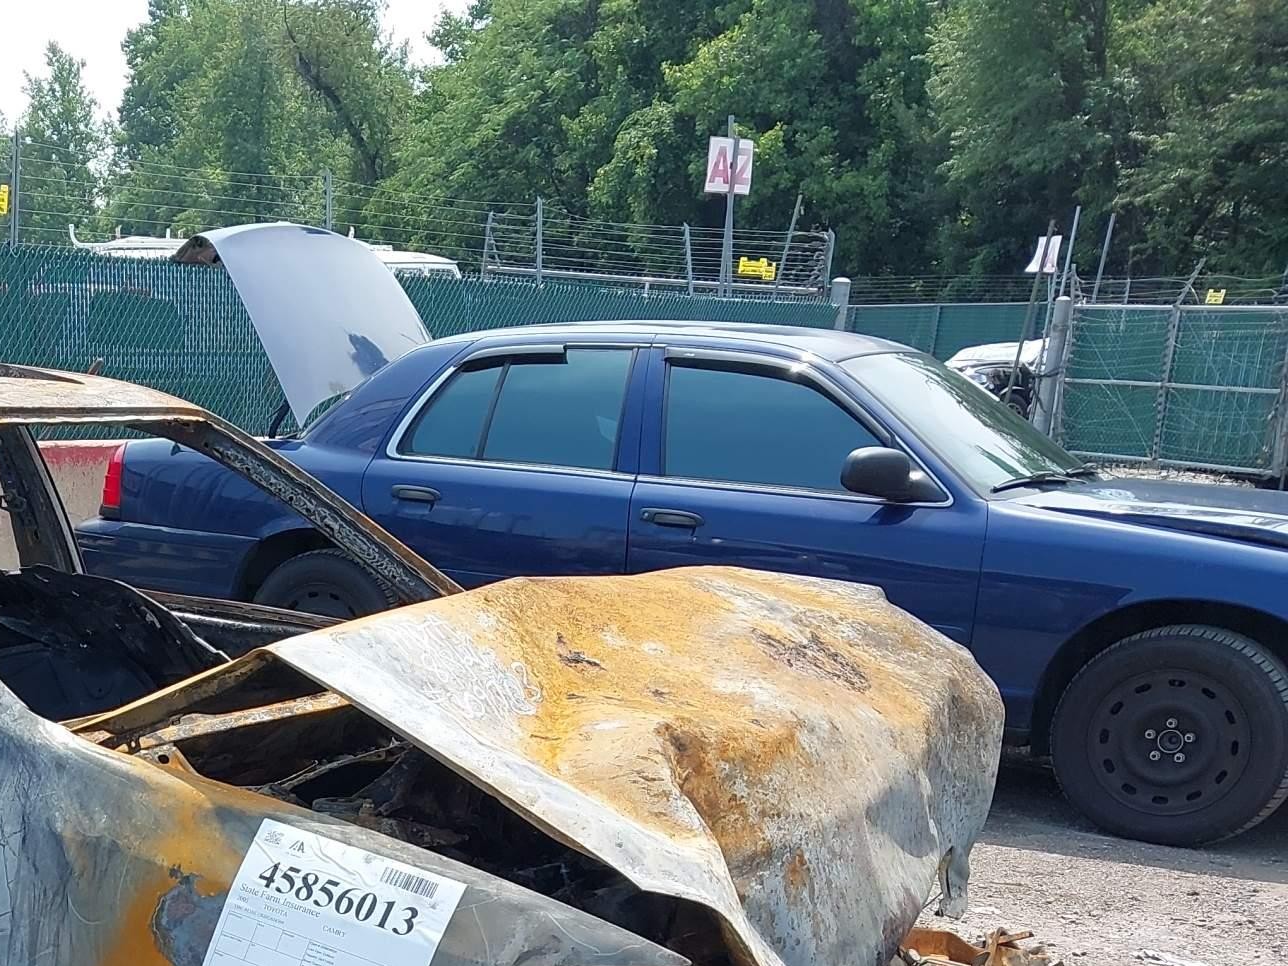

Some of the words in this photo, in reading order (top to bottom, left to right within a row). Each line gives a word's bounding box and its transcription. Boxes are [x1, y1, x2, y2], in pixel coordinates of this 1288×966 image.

[240, 882, 259, 897] State
[260, 890, 281, 905] Farm
[281, 898, 321, 918] Insurance
[258, 862, 419, 936] 45856013
[264, 904, 288, 918] TOYOTA
